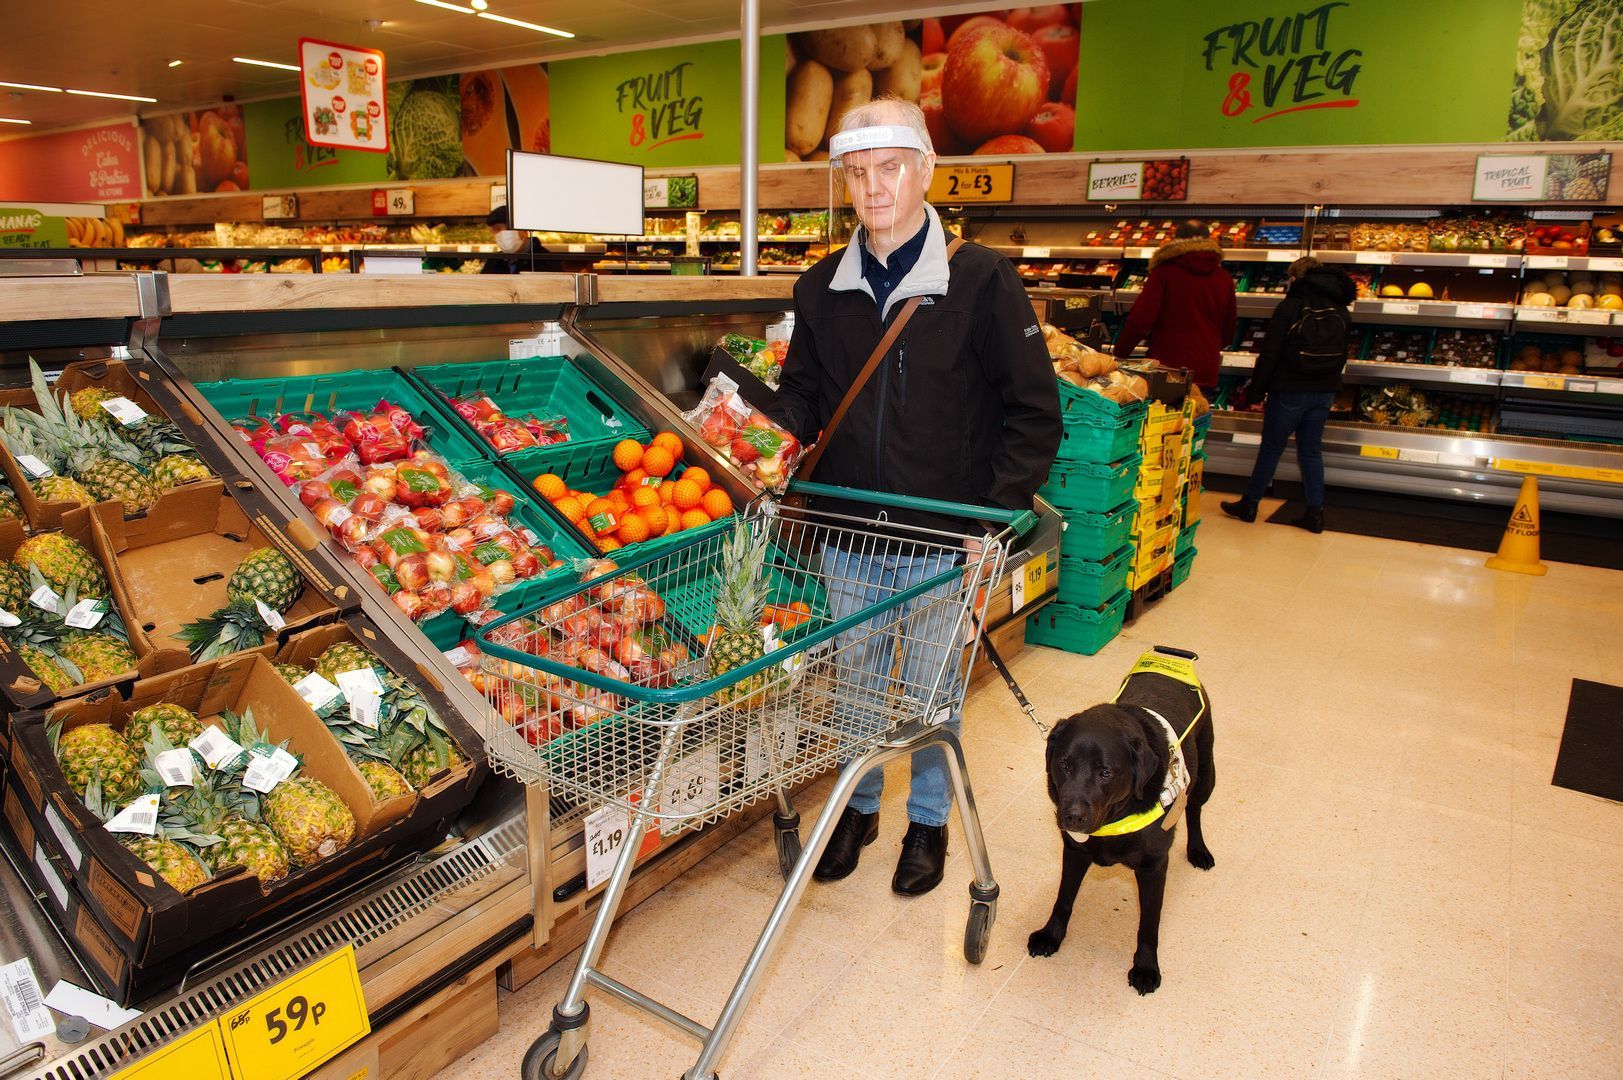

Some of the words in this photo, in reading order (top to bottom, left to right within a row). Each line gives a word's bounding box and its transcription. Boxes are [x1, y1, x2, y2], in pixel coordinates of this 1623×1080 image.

[1202, 2, 1349, 70] FRUIT
[616, 62, 693, 113] FRUIT
[1222, 72, 1254, 117] &
[1263, 49, 1362, 107] VEG
[629, 113, 648, 147] &
[651, 96, 703, 139] VEG
[82, 130, 131, 157] DELICIOUS
[856, 131, 888, 142] Shield
[948, 175, 959, 195] 2
[961, 181, 972, 189] for
[974, 175, 992, 195] £3
[1092, 172, 1137, 190] BERRIES
[1483, 166, 1532, 181] TROPICAL
[1501, 175, 1534, 189] FRUIT
[592, 828, 622, 856] £1.19
[265, 995, 326, 1045] 59p
